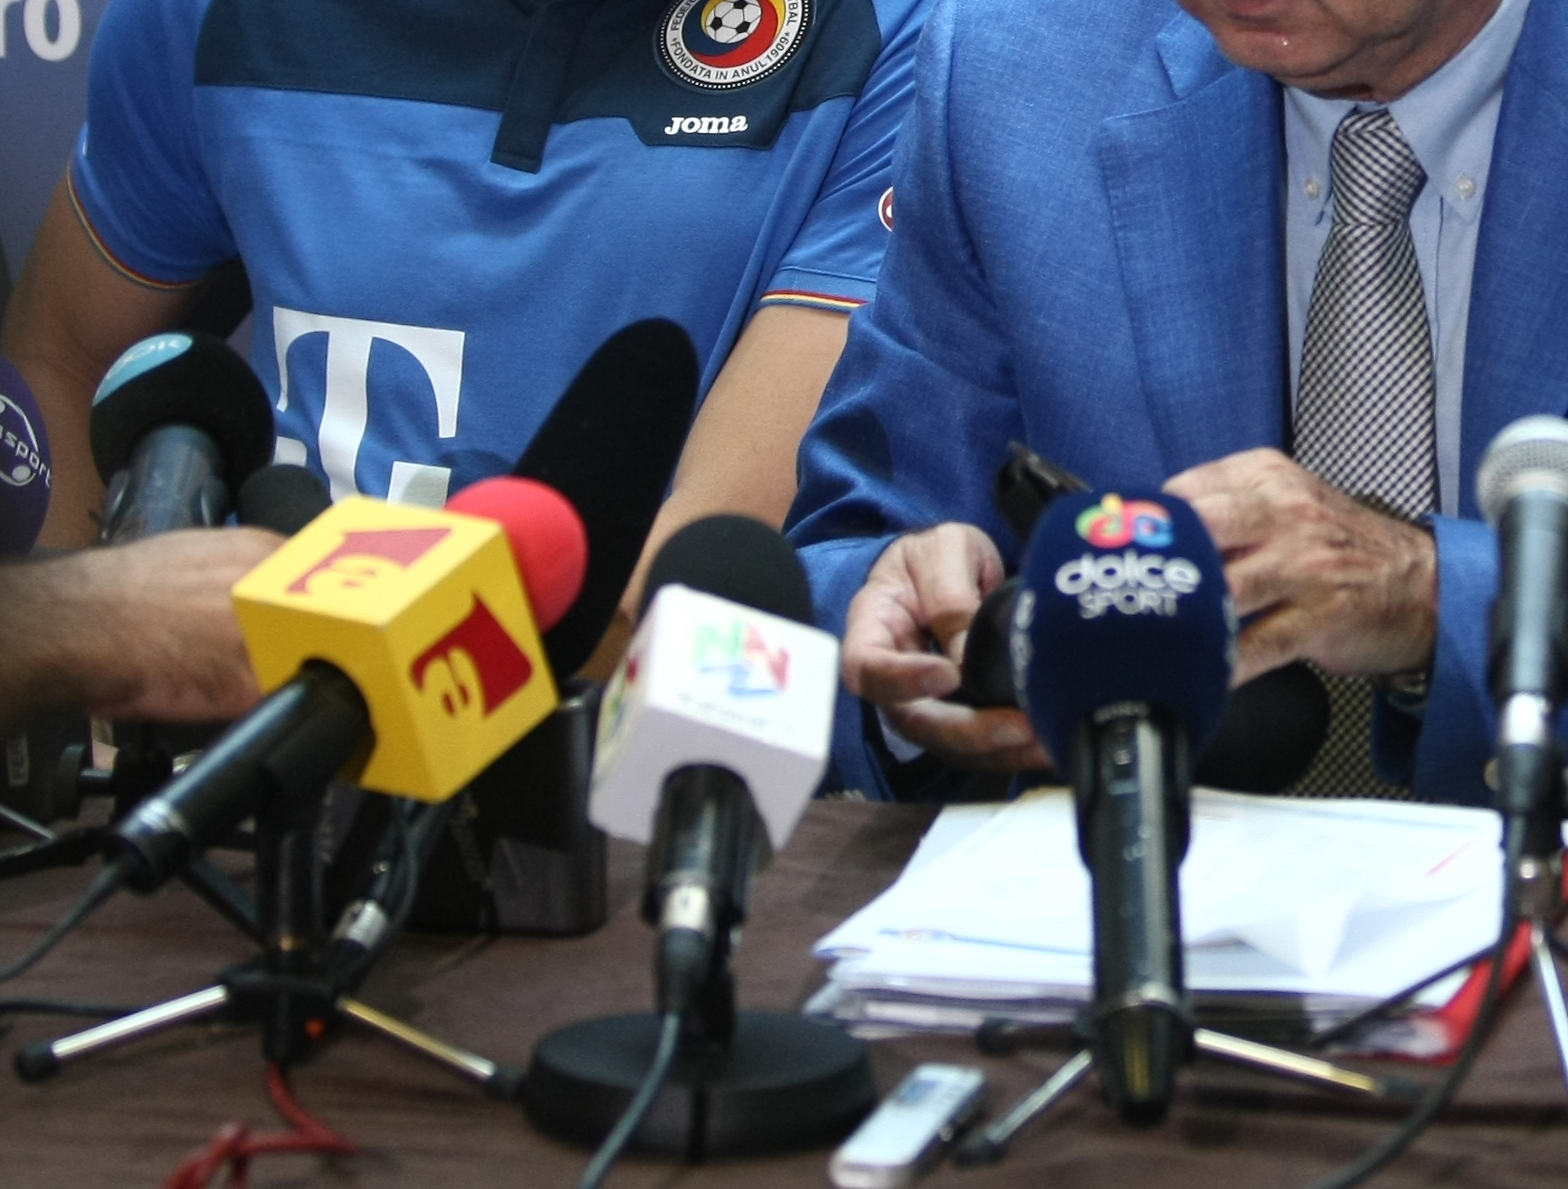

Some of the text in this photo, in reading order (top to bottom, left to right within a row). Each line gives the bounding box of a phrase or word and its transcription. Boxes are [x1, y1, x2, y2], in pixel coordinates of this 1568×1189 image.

[670, 36, 789, 79] FONDATA IN ANUL 1909
[1055, 549, 1201, 595] dolce
